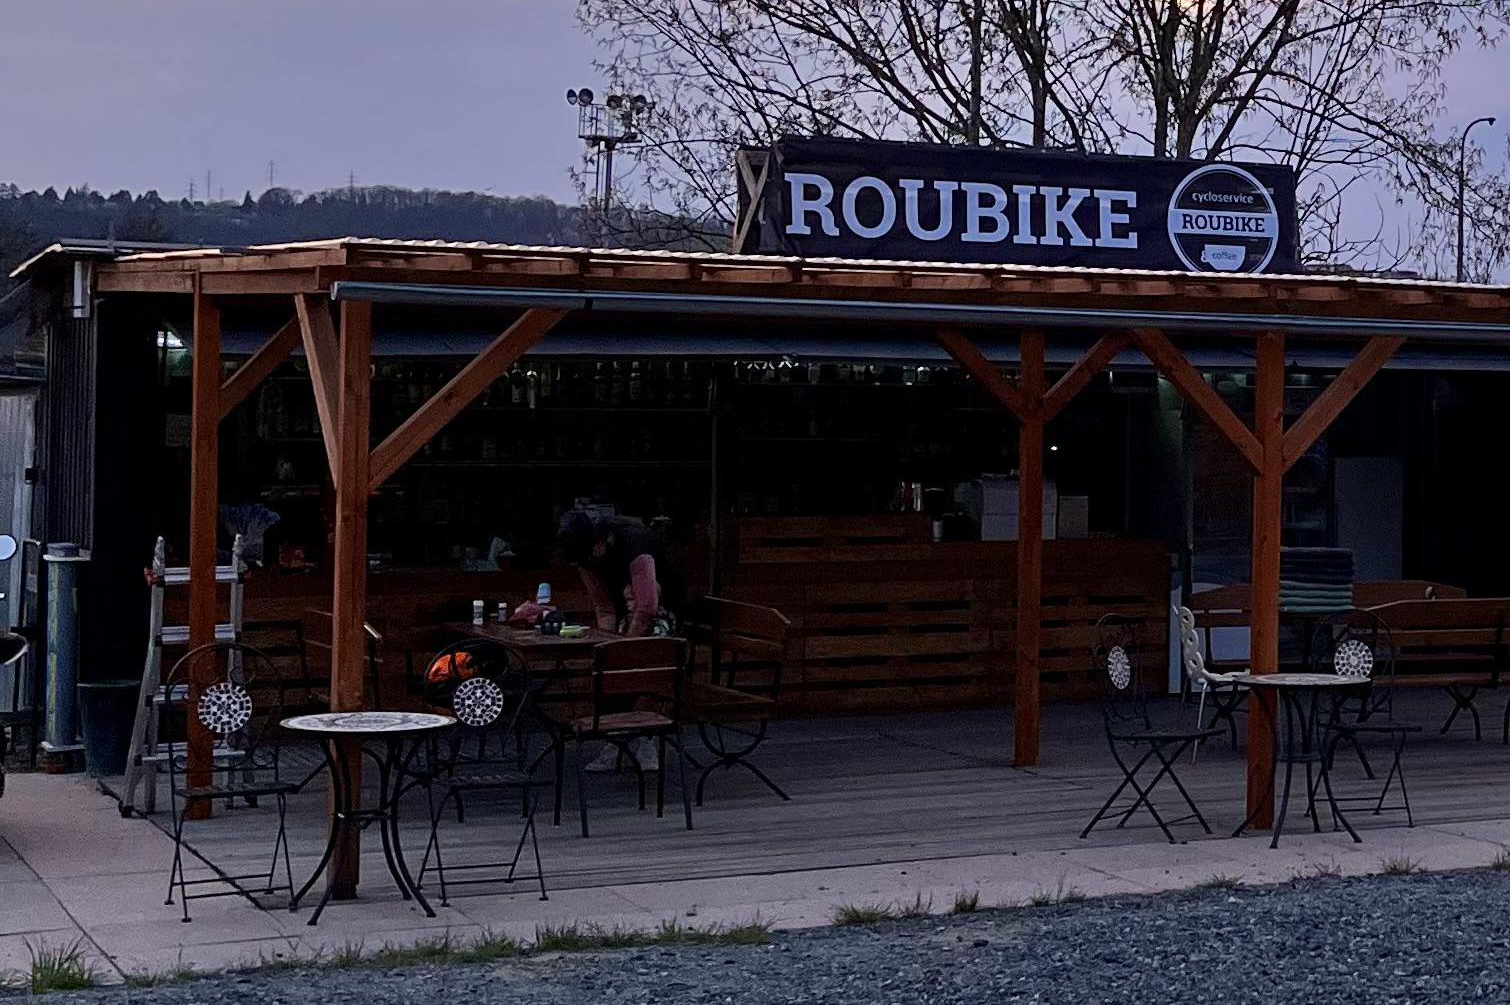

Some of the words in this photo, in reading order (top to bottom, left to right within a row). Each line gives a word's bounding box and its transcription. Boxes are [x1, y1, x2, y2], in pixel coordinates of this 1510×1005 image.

[1192, 191, 1254, 204] cycloservice
[784, 172, 1138, 249] ROUBIKE
[1181, 213, 1265, 232] ROUBIKE
[1211, 251, 1238, 261] coffee
